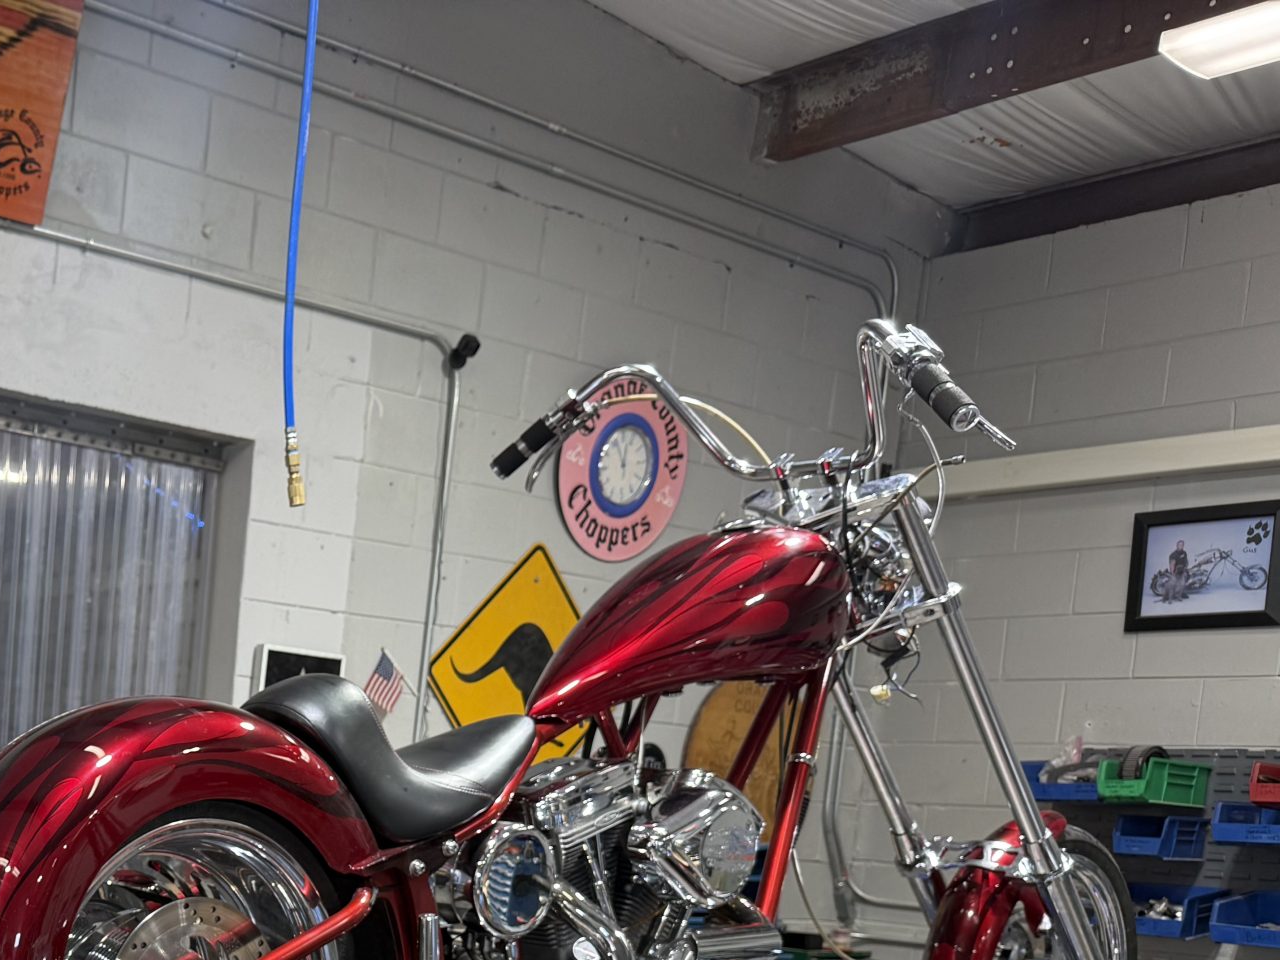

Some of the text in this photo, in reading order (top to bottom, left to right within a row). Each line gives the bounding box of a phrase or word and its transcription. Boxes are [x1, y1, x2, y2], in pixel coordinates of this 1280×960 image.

[19, 108, 44, 148] County
[579, 379, 649, 437] Oange
[567, 483, 651, 552] Choppers
[1242, 546, 1257, 554] Gus
